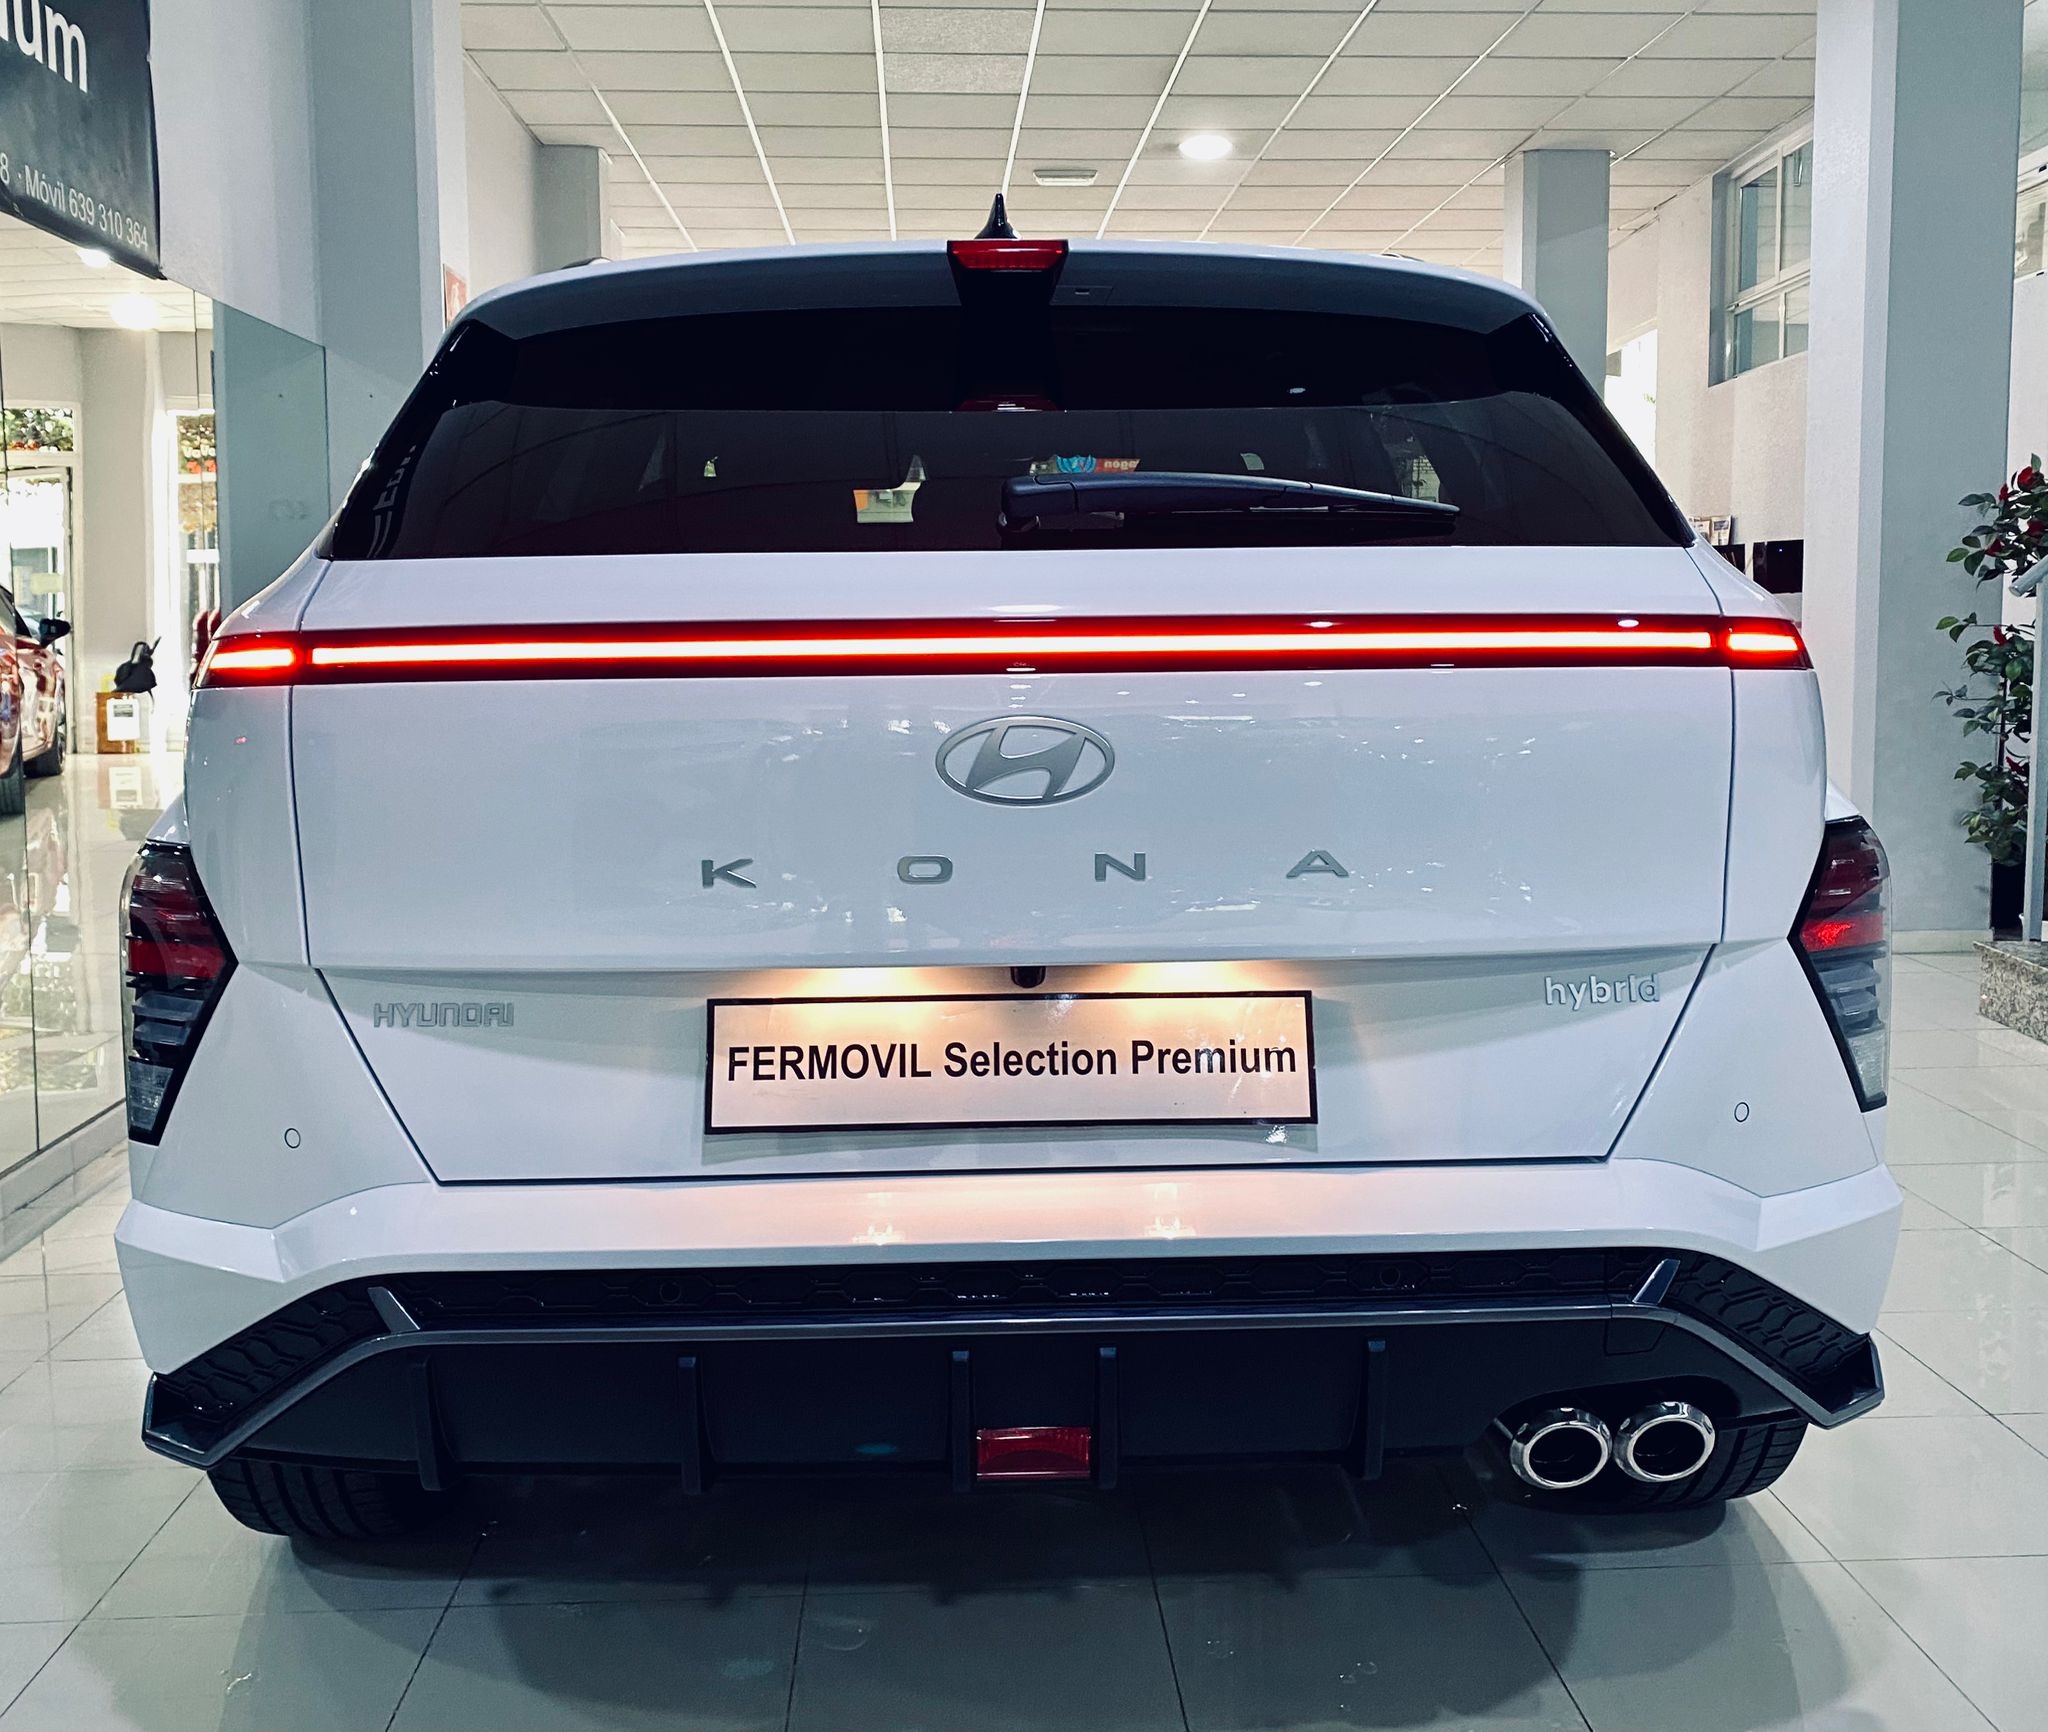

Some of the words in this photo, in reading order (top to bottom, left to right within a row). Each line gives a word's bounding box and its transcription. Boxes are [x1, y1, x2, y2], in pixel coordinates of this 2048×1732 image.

[24, 165, 66, 213] Móvil
[69, 188, 95, 226] 639
[98, 204, 123, 240] 310
[126, 218, 148, 251] 364
[701, 850, 1349, 889] KONA
[1544, 973, 1660, 1011] hybrid
[373, 1003, 514, 1028] HYUNDAI
[727, 1043, 932, 1081] FERMOVIL
[943, 1041, 1117, 1077] Selection
[1131, 1040, 1297, 1075] Premium
